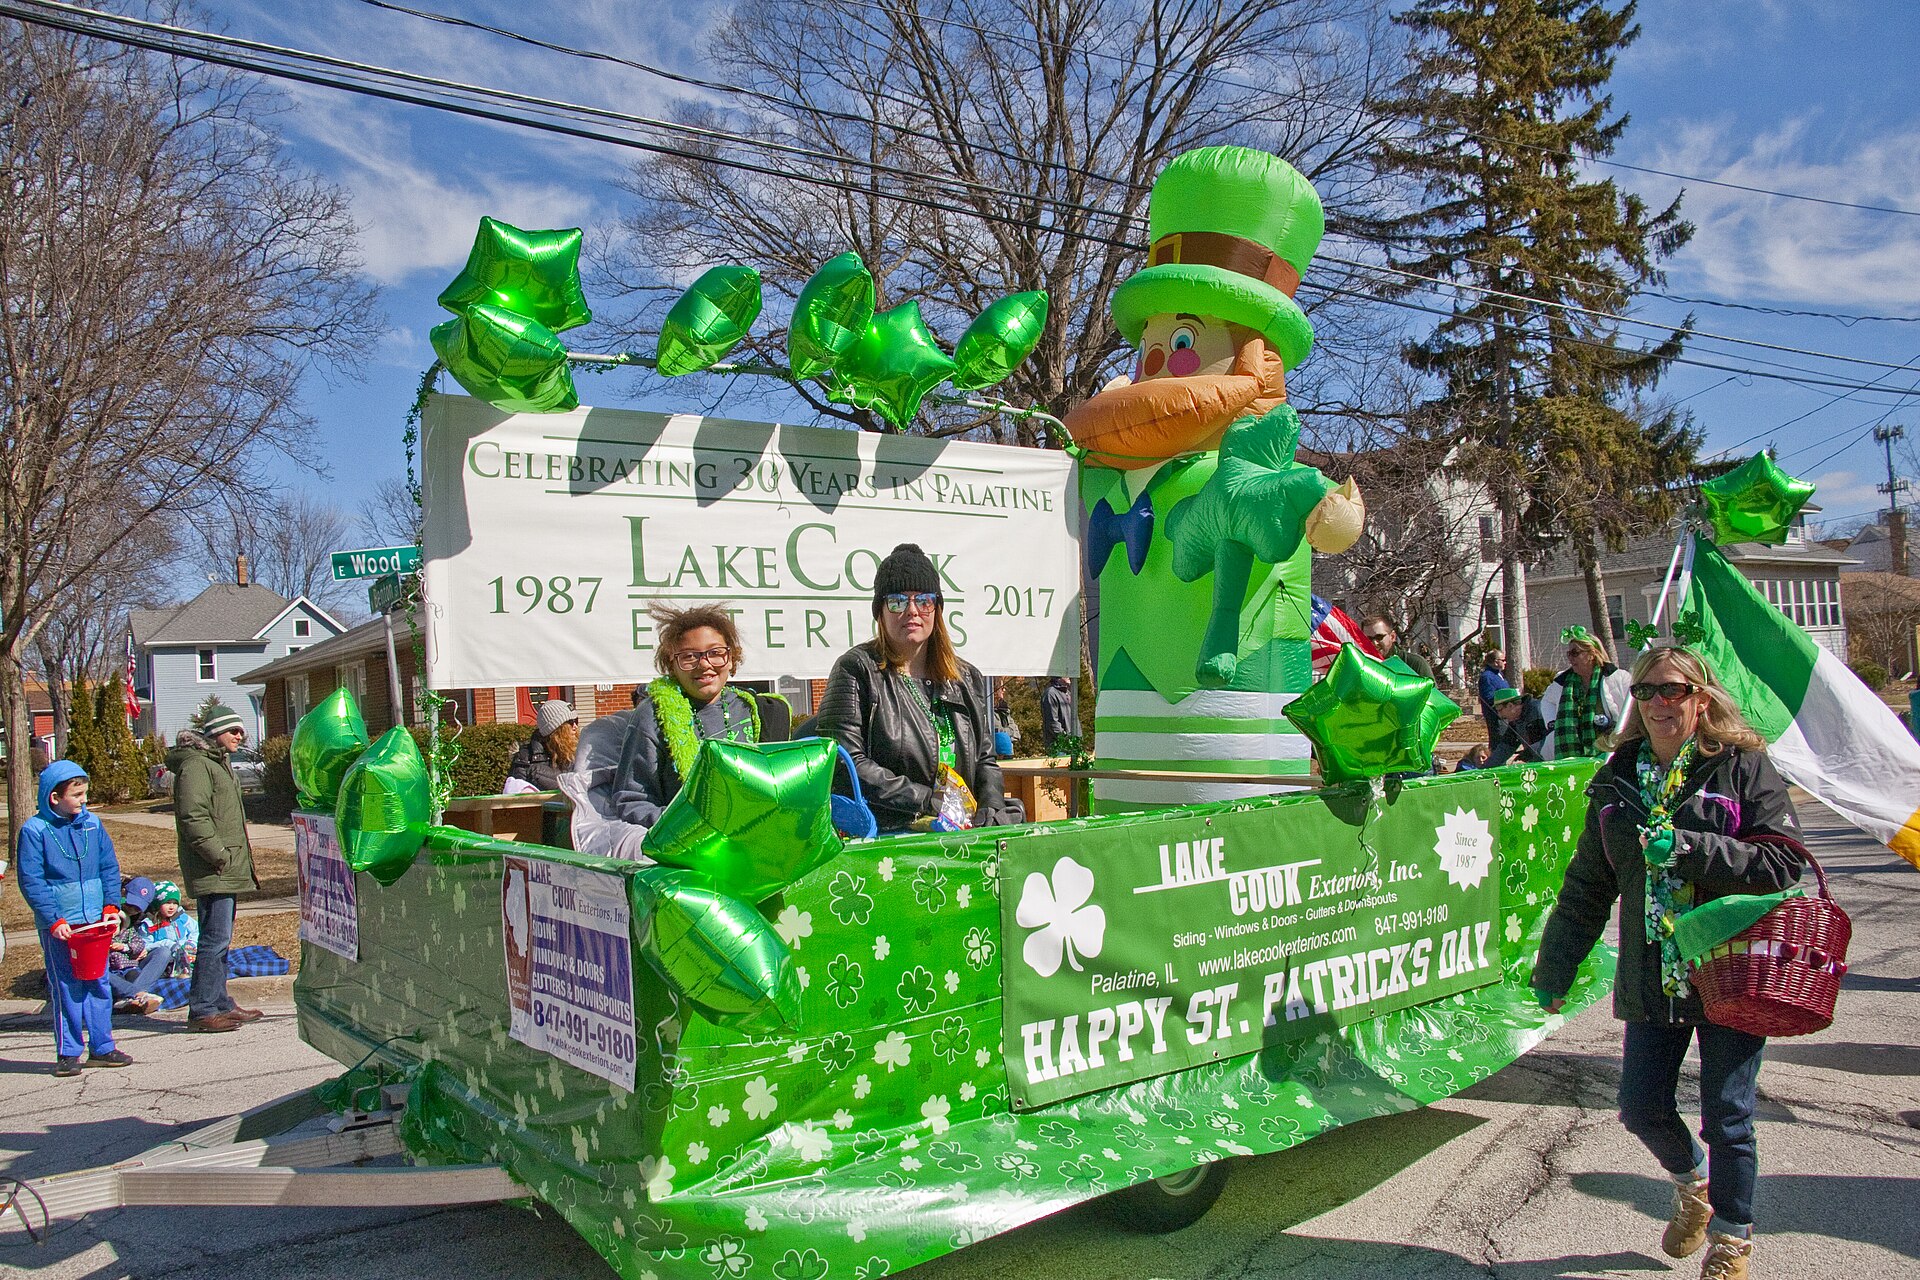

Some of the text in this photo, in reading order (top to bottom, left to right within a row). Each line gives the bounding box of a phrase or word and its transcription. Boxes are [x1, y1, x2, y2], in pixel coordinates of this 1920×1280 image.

[468, 441, 1054, 513] CELEBRATING 30 YEARS IN PALATINE
[338, 565, 346, 577] E
[350, 551, 402, 575] Wood
[487, 575, 603, 615] 1987
[983, 584, 1055, 618] 2017
[631, 608, 968, 650] EERIS
[1454, 831, 1478, 848] Since
[530, 861, 552, 885] LAKE
[1158, 836, 1226, 886] LAKE
[1455, 853, 1477, 869] 1987
[552, 886, 577, 912] COOK
[578, 899, 613, 924] Exteriors,
[1229, 864, 1303, 916] COOK
[1388, 859, 1423, 884] Inc.
[1172, 931, 1206, 948] Siding
[1214, 921, 1260, 940] Windows
[1261, 917, 1270, 931] &
[1271, 913, 1298, 929] Doors
[1305, 904, 1336, 921] Gutters
[1337, 901, 1344, 914] &
[1198, 903, 1449, 977] www.lakecookexteriors.com 847-991-9180
[569, 956, 576, 975] &
[577, 959, 605, 984] DOORS
[1091, 962, 1179, 996] Palatine, IL
[532, 971, 567, 997] GUTTERS
[566, 981, 573, 1001] &
[574, 985, 631, 1021] DOWNSPOUTS
[1021, 920, 1491, 1085] HAPPY ST. PATRICK'S DAY
[533, 999, 635, 1064] 847-991-9180
